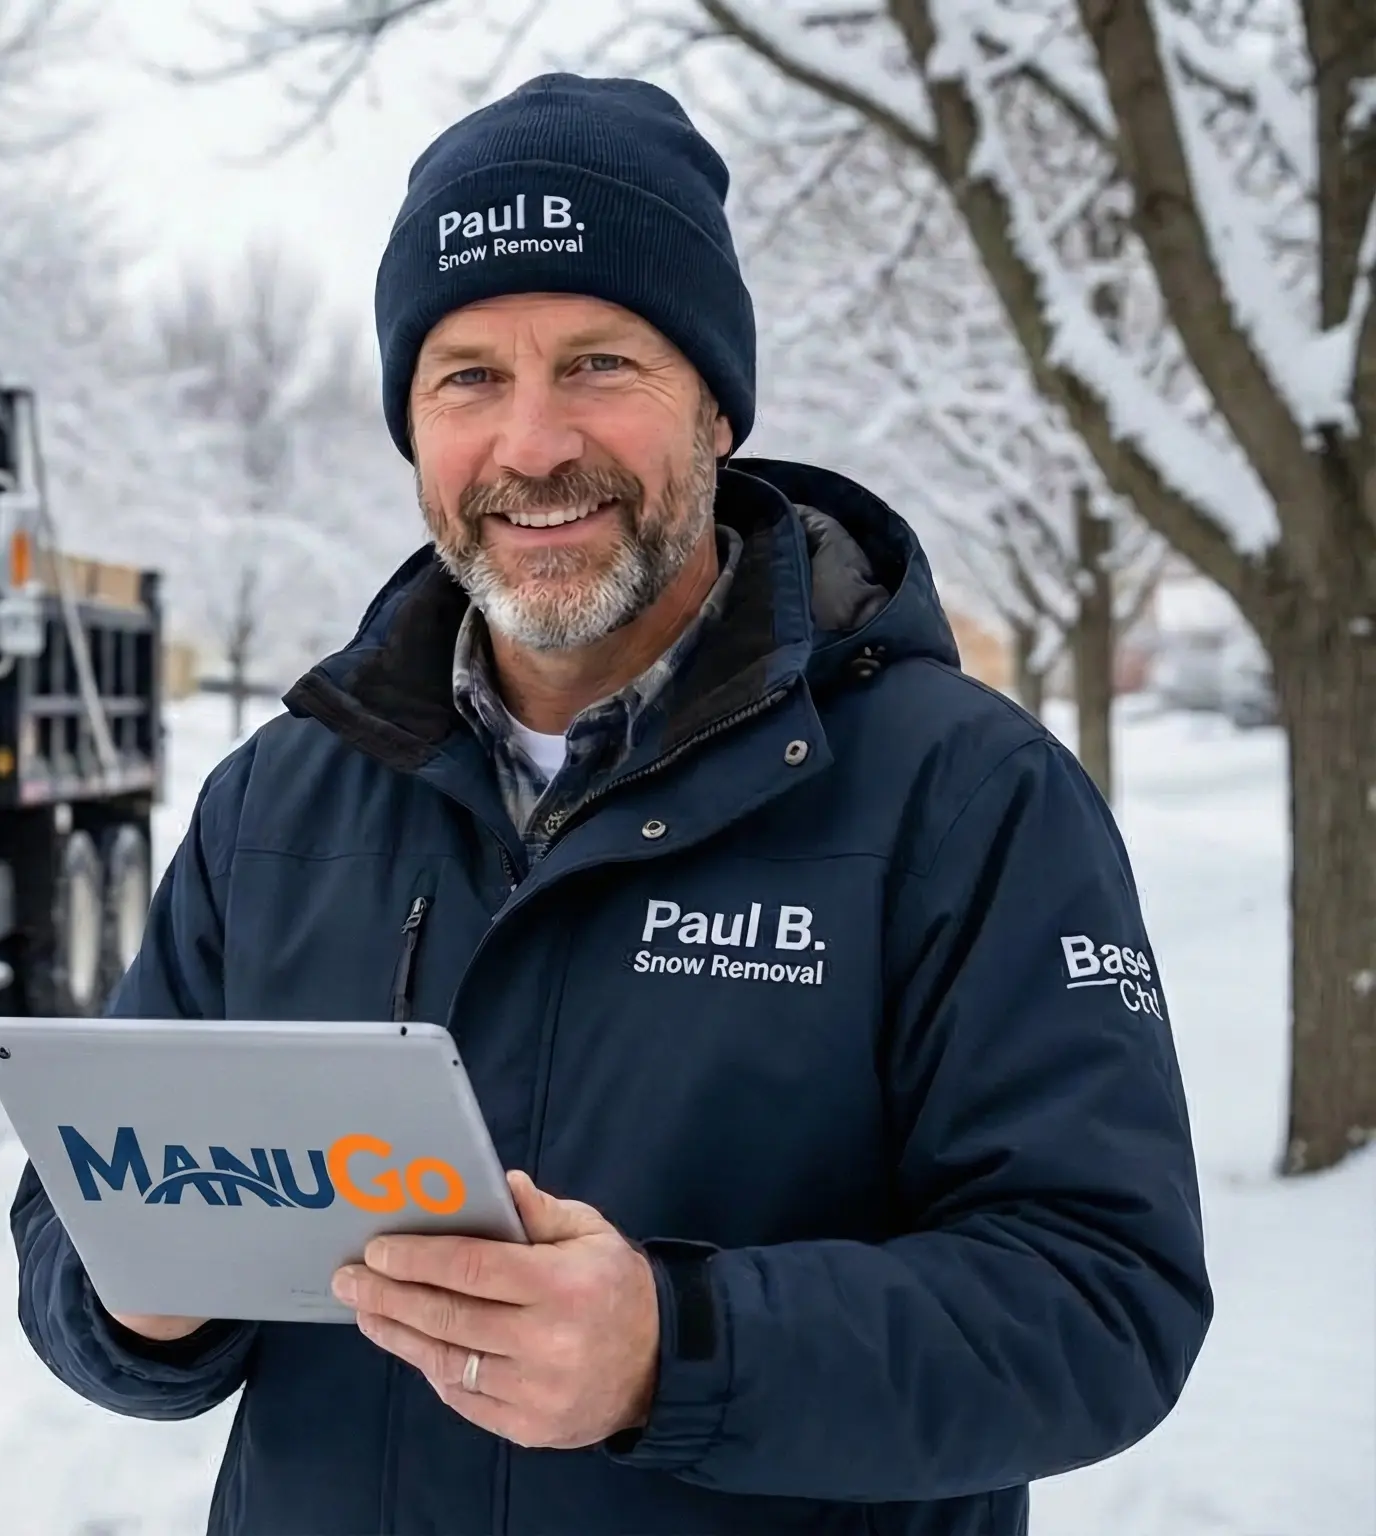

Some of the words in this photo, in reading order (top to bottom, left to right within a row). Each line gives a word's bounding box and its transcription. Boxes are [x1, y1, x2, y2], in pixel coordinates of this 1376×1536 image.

[438, 194, 526, 251] Paul
[543, 195, 585, 231] B.
[438, 245, 487, 271] Snow
[494, 235, 584, 256] Removal
[641, 899, 762, 948] Paul
[775, 905, 826, 951] B.
[633, 950, 706, 975] Snow
[710, 954, 824, 985] Removal
[1060, 935, 1152, 982] Base
